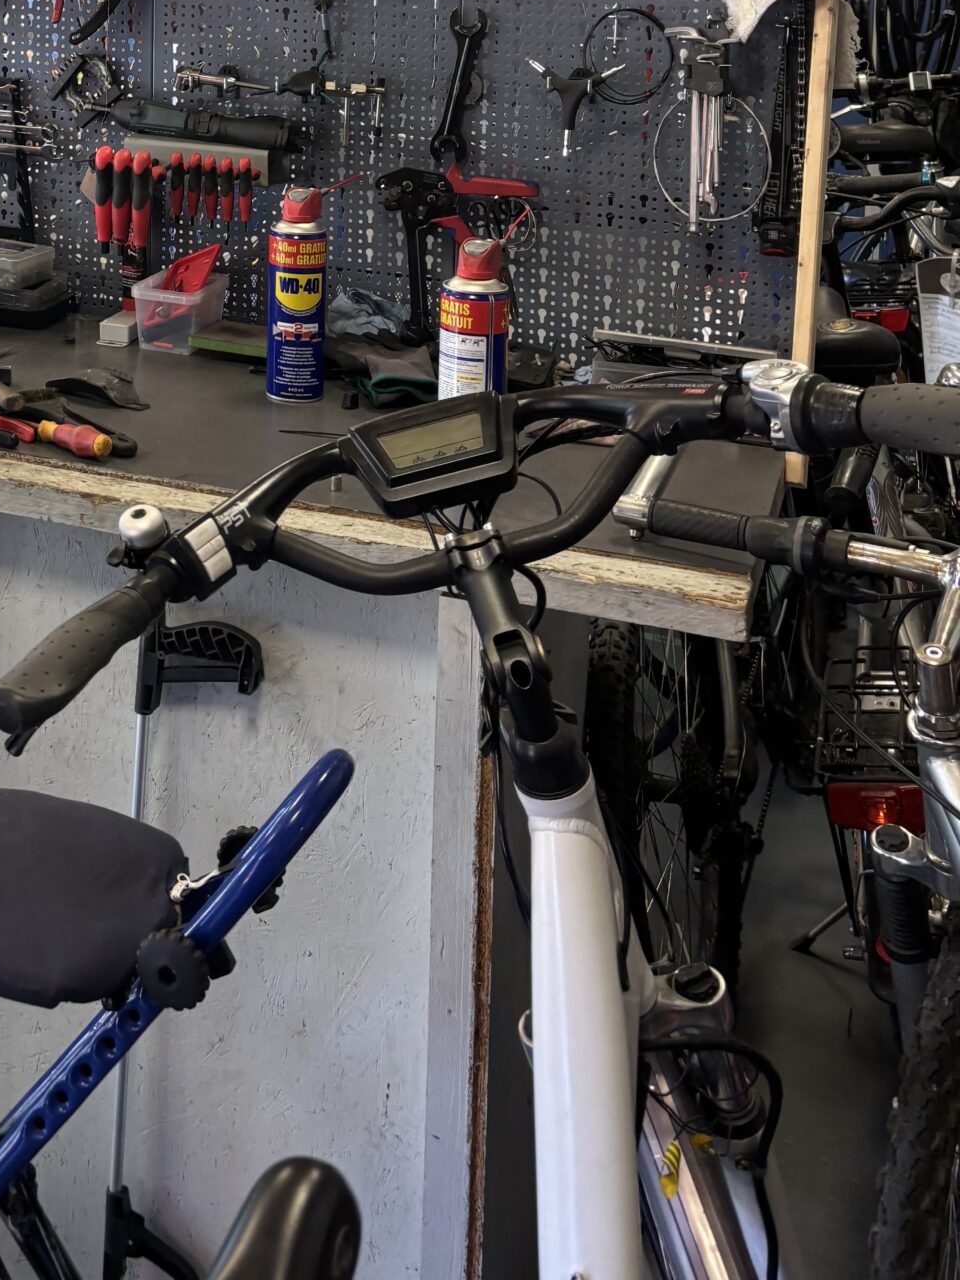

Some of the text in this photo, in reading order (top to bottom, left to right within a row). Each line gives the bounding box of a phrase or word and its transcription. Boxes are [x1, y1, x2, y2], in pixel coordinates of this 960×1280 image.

[272, 241, 326, 254] +40ml GRATIS
[271, 252, 294, 265] +40ml
[279, 276, 320, 294] WD-40
[440, 298, 470, 316] GRATIS
[440, 310, 474, 329] GRATUIT
[294, 323, 303, 333] 2
